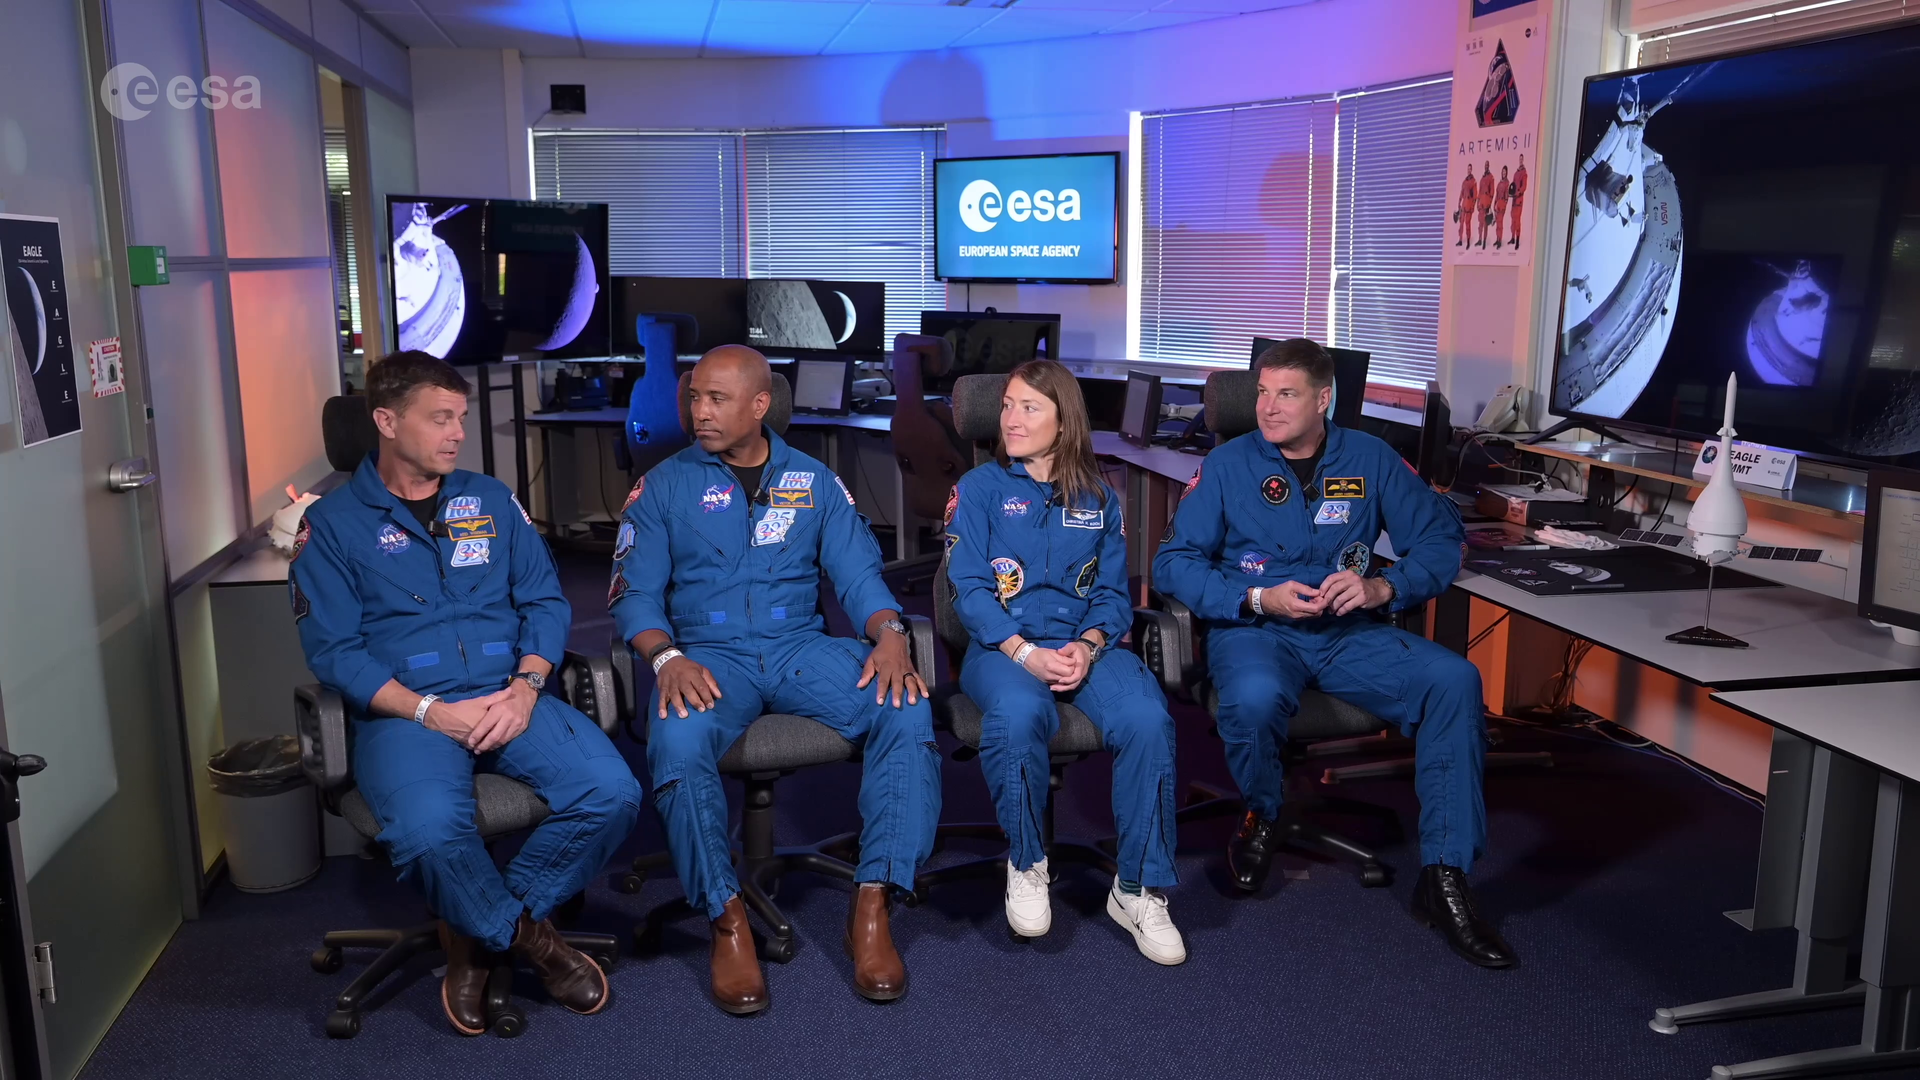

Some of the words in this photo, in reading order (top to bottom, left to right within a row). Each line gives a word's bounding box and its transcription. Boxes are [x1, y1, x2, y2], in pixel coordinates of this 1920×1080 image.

[1459, 135, 1518, 155] ARTEMIS
[1524, 132, 1531, 148] II
[1007, 188, 1081, 222] esa
[1660, 201, 1668, 226] NASA
[22, 245, 43, 257] EAGLE
[959, 245, 1008, 257] EUROPEAN
[1010, 245, 1040, 257] SPACE
[1041, 245, 1081, 257] AGENCY
[1731, 450, 1761, 464] EAGLE
[703, 493, 732, 503] NASA
[1004, 503, 1027, 511] NASA
[380, 533, 408, 545] NASA
